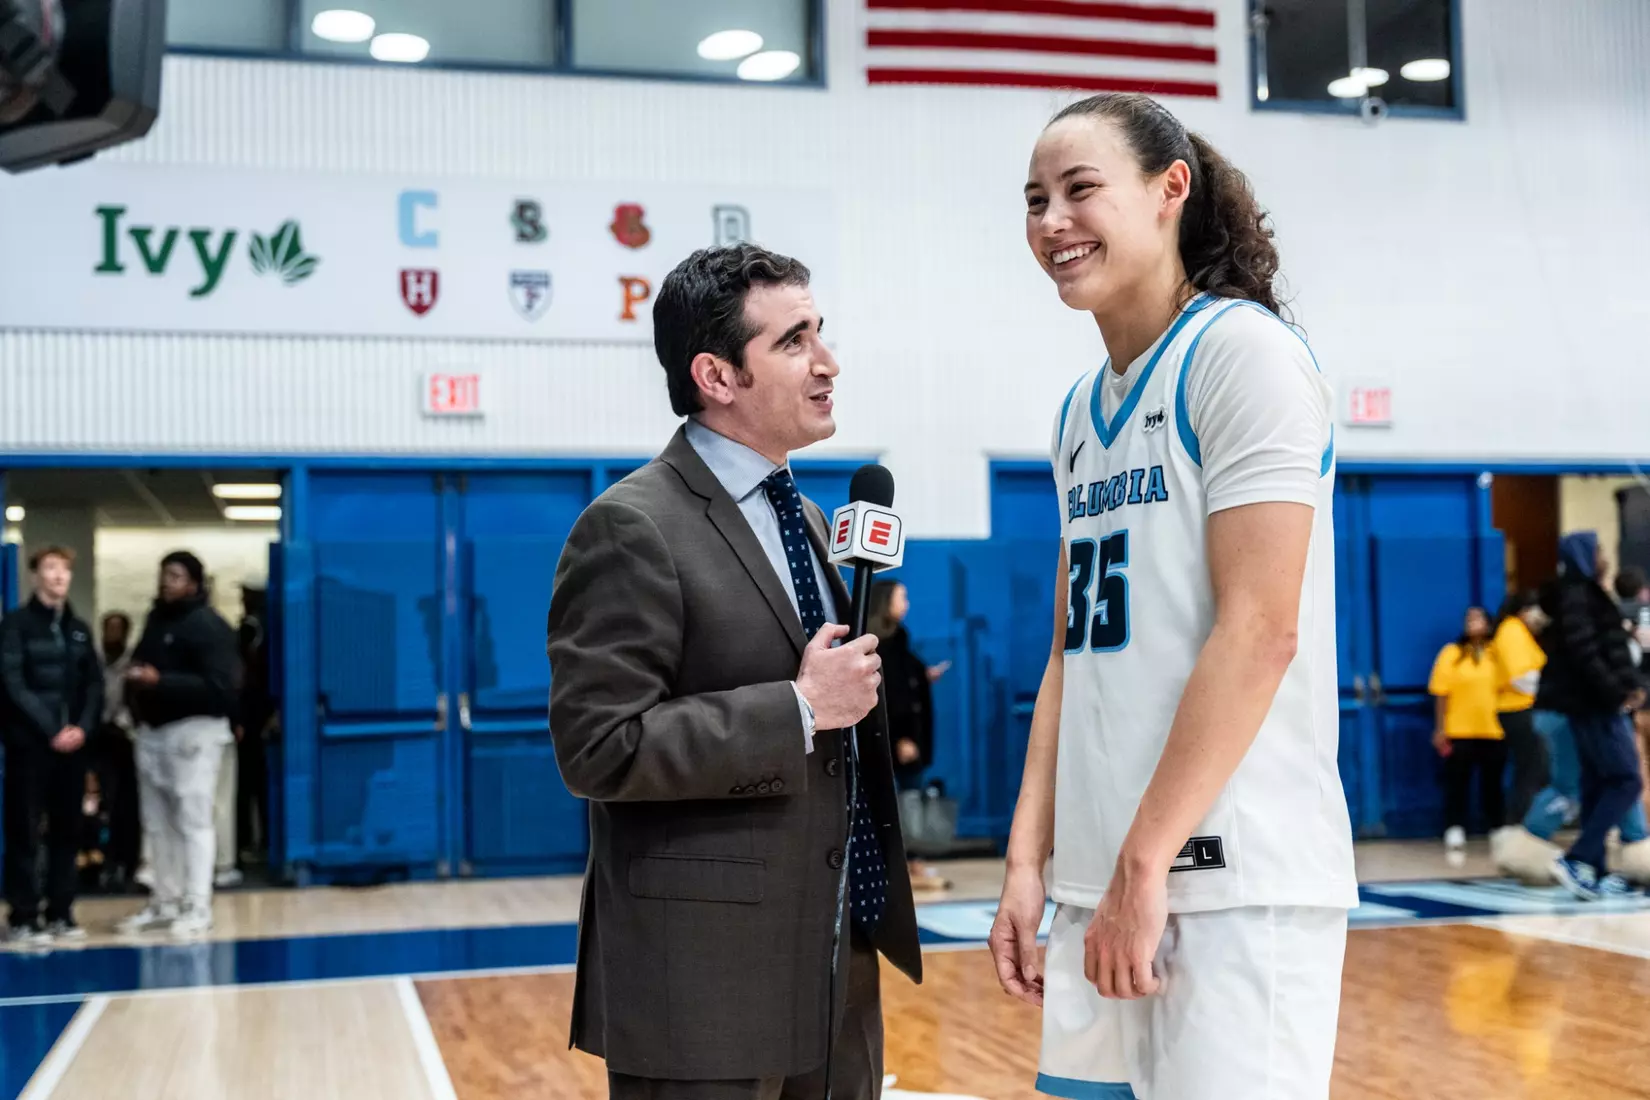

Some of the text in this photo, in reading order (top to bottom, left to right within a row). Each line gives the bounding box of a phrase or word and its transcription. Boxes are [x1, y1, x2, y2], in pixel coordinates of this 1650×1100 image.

[398, 190, 437, 248] C
[95, 206, 238, 297] Ivy
[618, 276, 650, 320] P
[430, 374, 479, 411] EXIT
[1068, 465, 1168, 523] LUMBIA
[1063, 528, 1130, 655] 35
[1202, 846, 1212, 860] L
